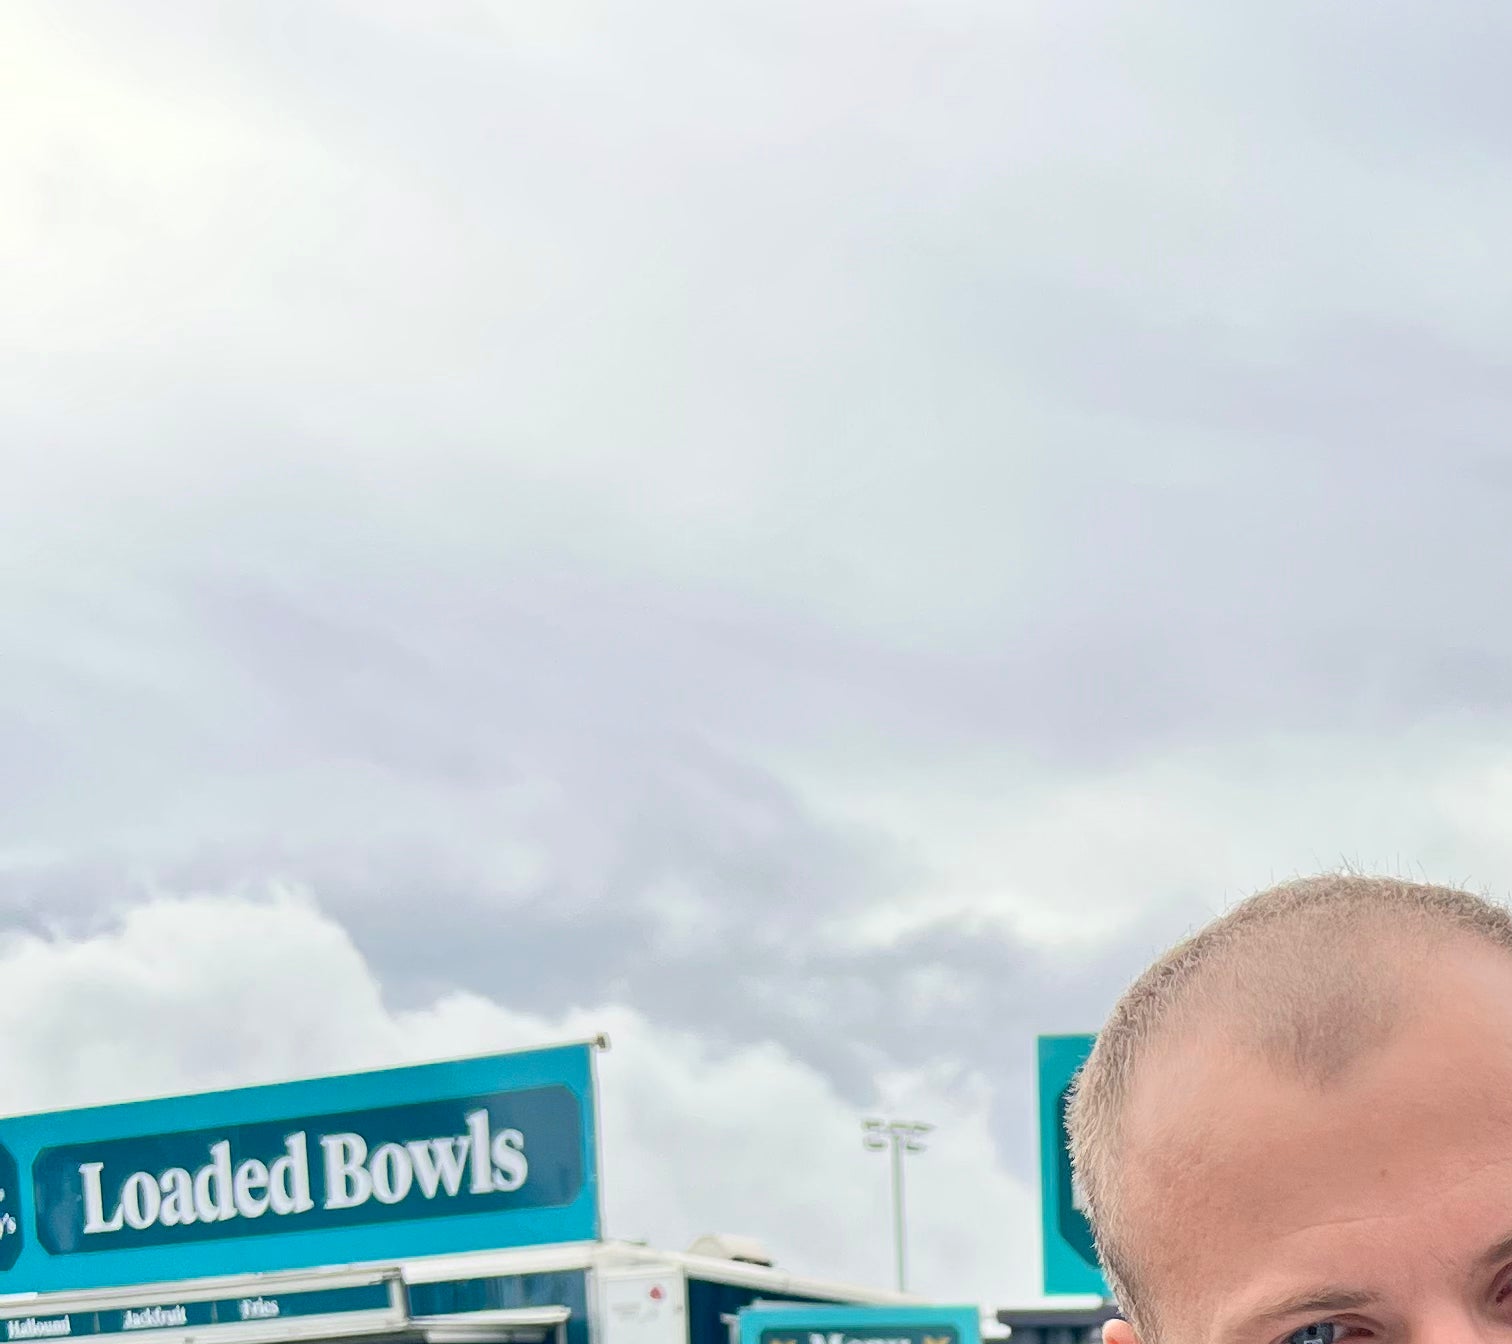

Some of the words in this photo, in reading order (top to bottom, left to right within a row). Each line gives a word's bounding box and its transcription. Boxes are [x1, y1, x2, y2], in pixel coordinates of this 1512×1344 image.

[79, 1131, 315, 1235] Loaded
[319, 1107, 529, 1211] Bowls
[122, 1304, 188, 1330] Jackfruit
[238, 1296, 280, 1320] Fries
